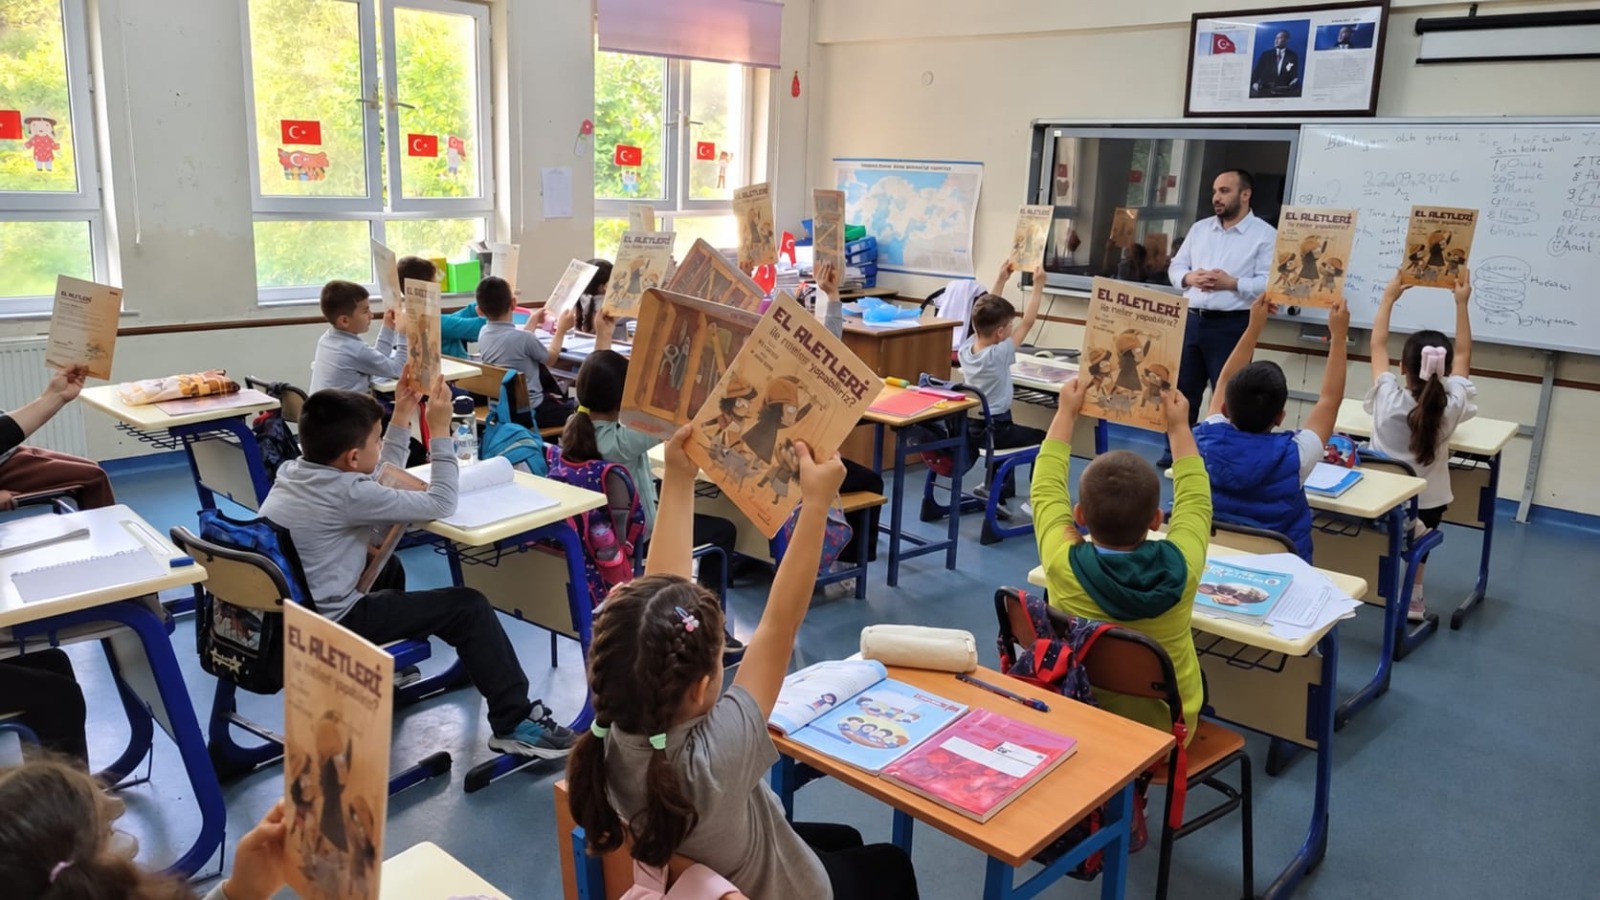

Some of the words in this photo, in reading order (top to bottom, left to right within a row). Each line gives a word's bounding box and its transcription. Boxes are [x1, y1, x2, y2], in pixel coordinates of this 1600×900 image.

[1285, 211, 1298, 221] EL
[1300, 213, 1352, 224] ALETLERİ
[1414, 210, 1427, 218] EL
[1097, 287, 1113, 303] EL
[1117, 292, 1181, 319] ALETLERİ
[772, 305, 792, 332] EL
[793, 324, 870, 401] ALETLERİ
[288, 624, 306, 653] EL
[309, 634, 382, 699] ALETLERİ
